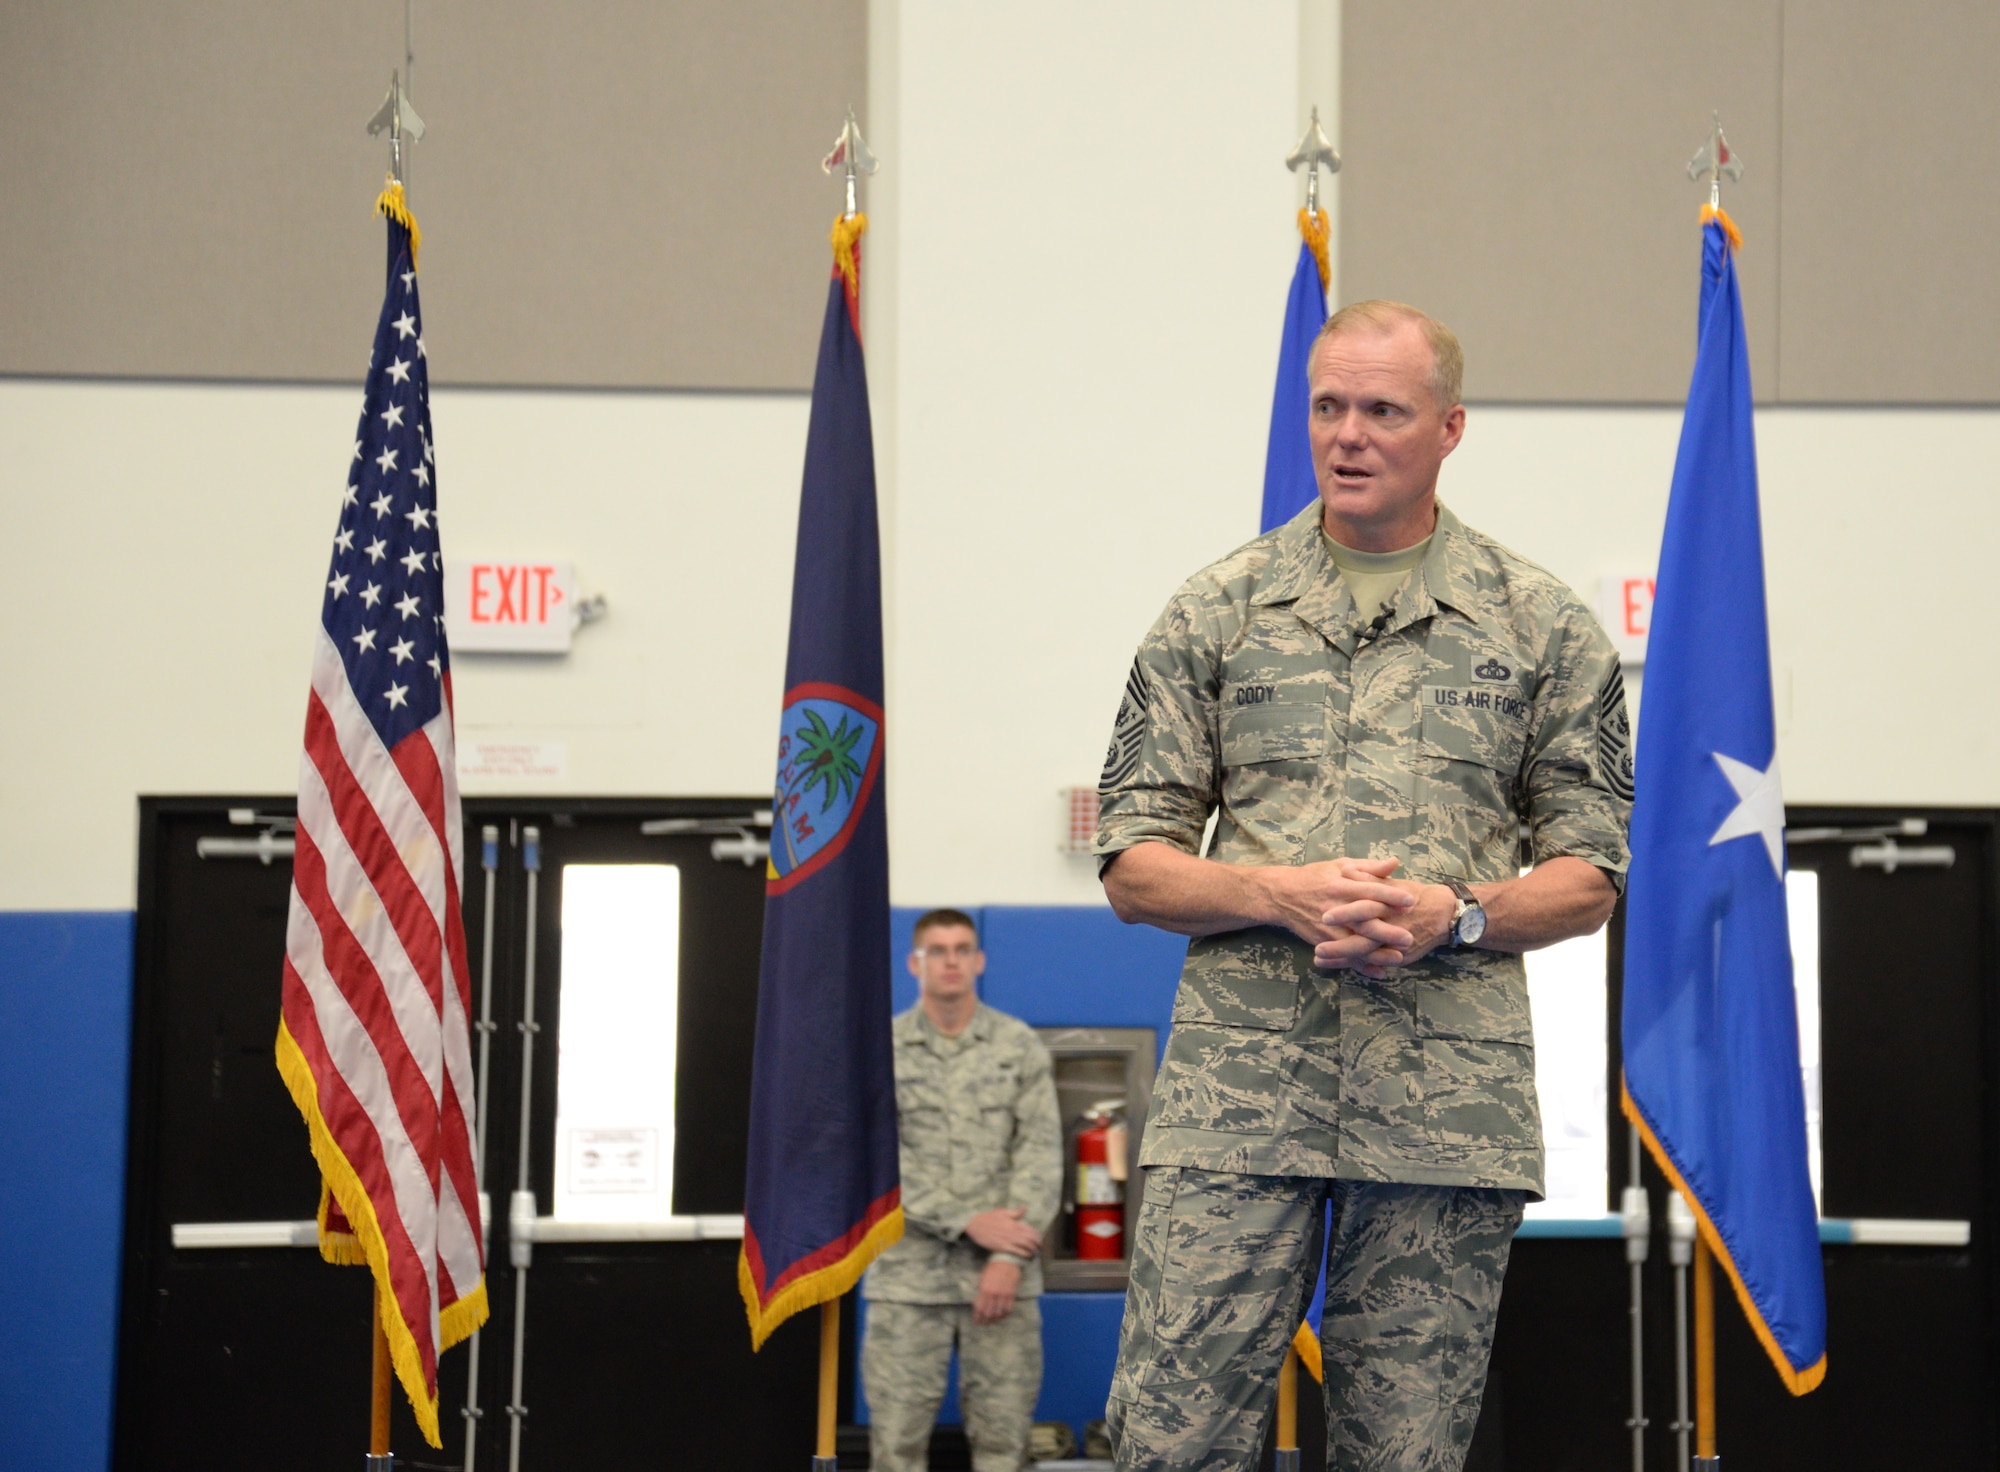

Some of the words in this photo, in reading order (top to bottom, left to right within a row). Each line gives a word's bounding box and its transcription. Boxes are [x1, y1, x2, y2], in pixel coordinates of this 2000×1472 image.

[470, 565, 554, 623] EXIT
[1237, 686, 1275, 705] CODY
[1465, 691, 1491, 709] AIR
[1495, 695, 1527, 720] FORCE
[778, 735, 815, 843] GUAM
